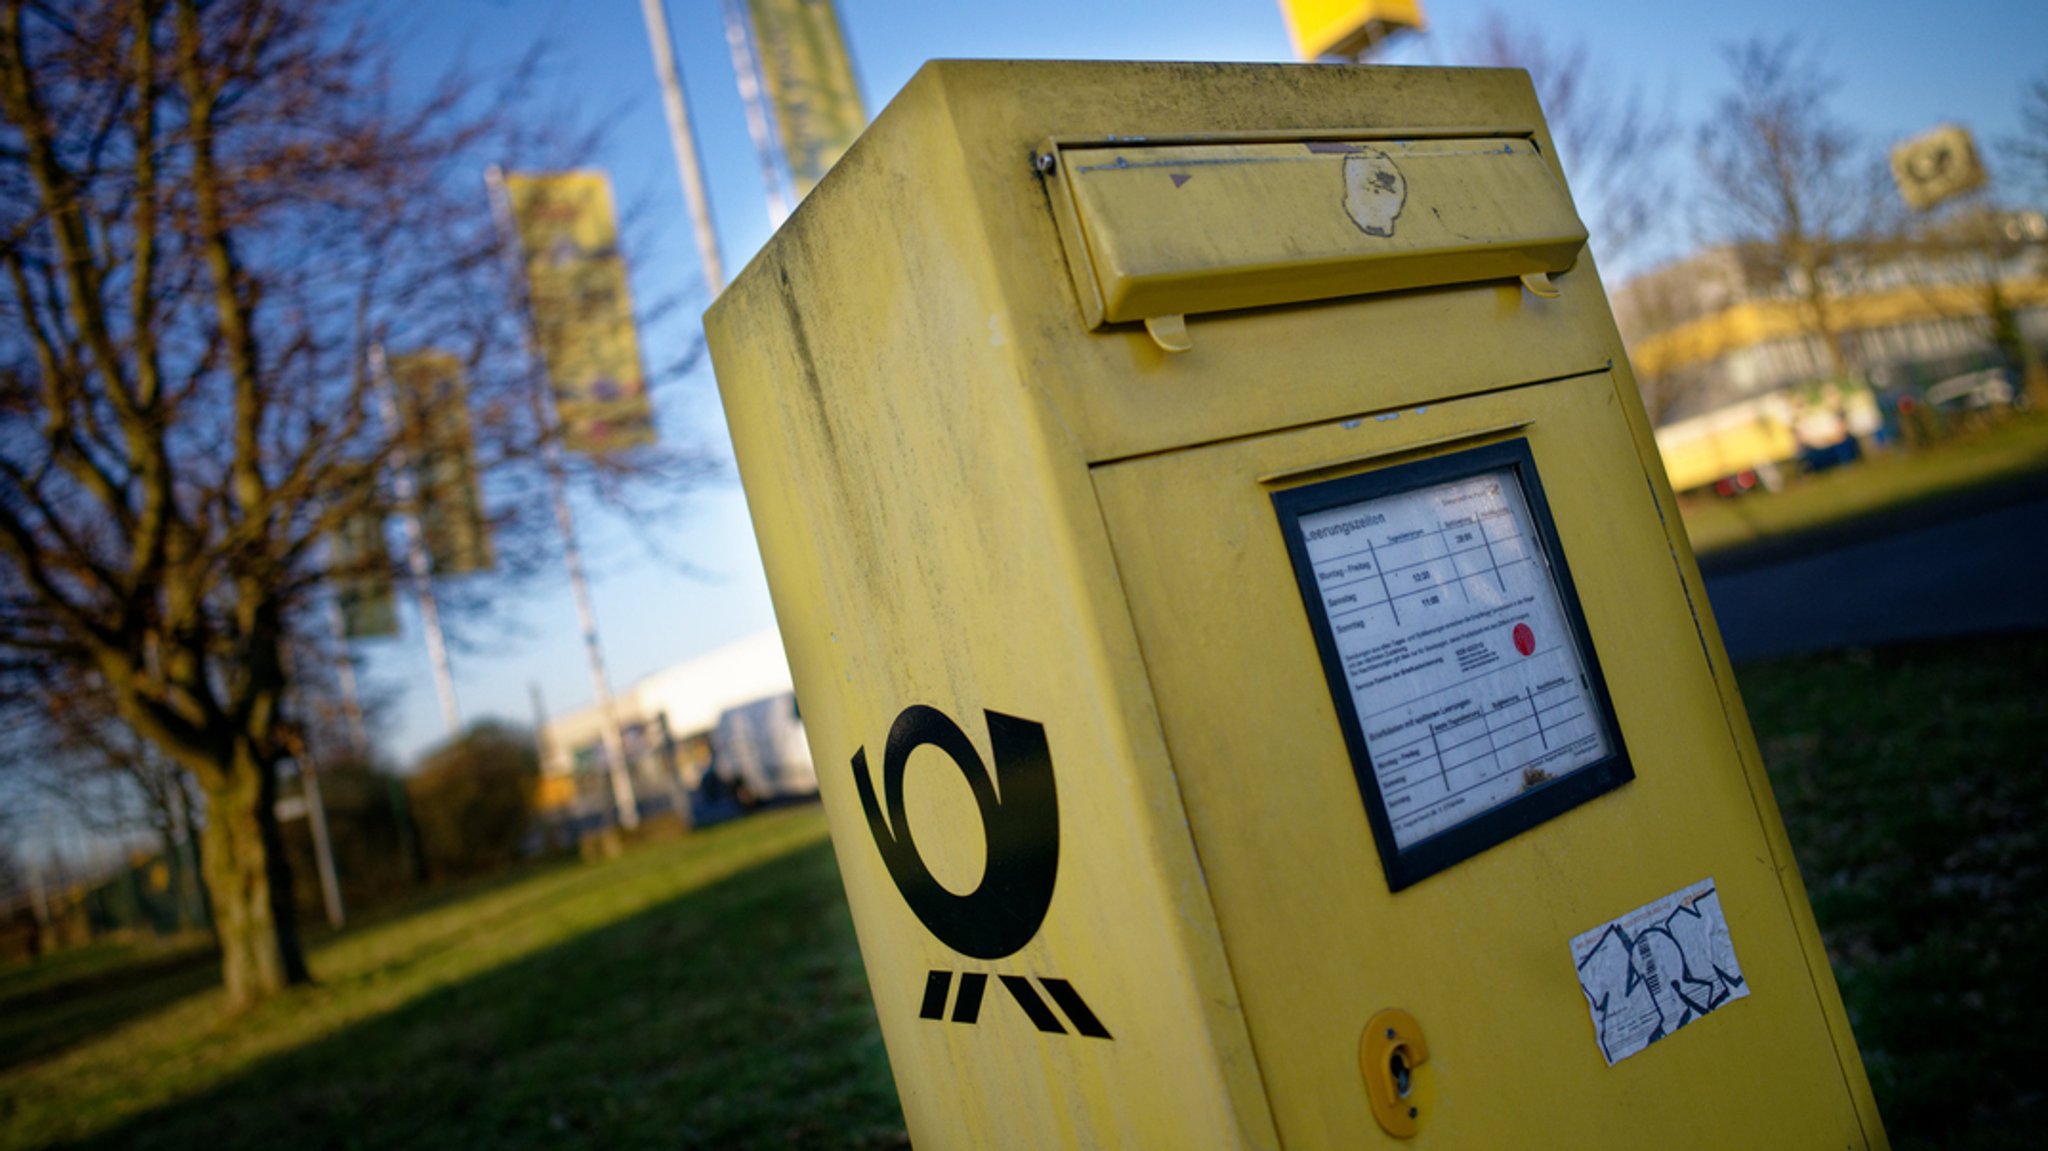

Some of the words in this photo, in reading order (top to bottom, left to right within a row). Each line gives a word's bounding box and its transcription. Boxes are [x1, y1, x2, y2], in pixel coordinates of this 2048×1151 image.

[1307, 513, 1386, 542] eerungszeiten
[1318, 568, 1345, 581] Montag
[1347, 561, 1372, 572] Freitag
[1327, 593, 1358, 608] Samstag
[1335, 620, 1366, 634] Sonntag
